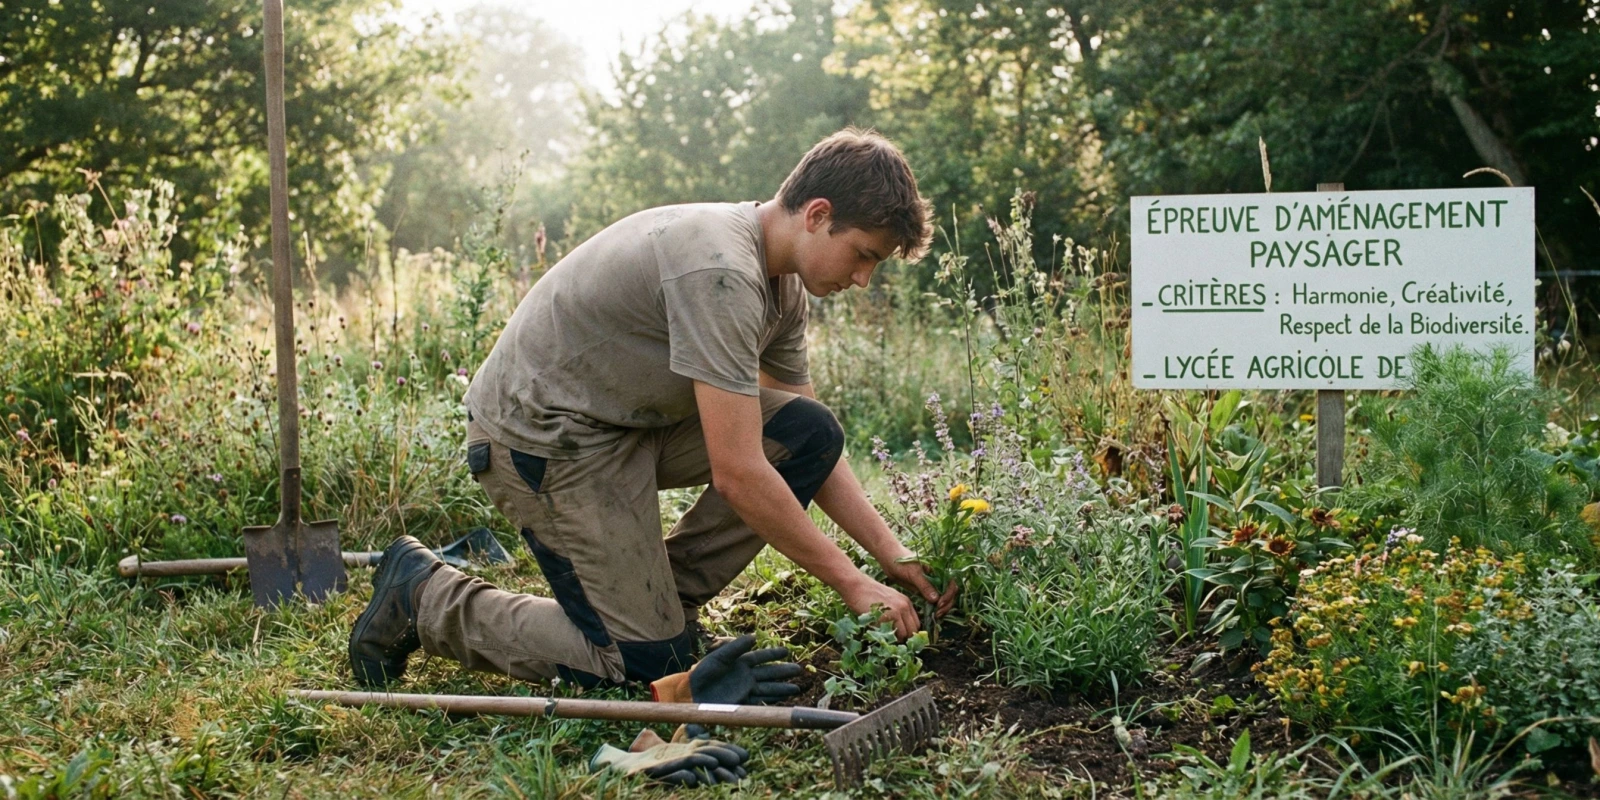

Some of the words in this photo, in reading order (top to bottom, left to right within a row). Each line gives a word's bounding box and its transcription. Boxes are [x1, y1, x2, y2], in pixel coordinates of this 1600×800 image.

[1147, 199, 1260, 235] ÉPREUVE
[1275, 196, 1509, 232] D'AMÉNAGEMENT
[1250, 239, 1403, 268] PAYSAGER
[1158, 278, 1267, 307] CRITÈRES
[1292, 282, 1396, 308] Harmonie,
[1401, 280, 1513, 307] Créativité,
[1280, 313, 1353, 342] Respect
[1359, 313, 1381, 335] de
[1388, 313, 1404, 335] la
[1410, 312, 1530, 335] Biodiversité.
[1164, 348, 1235, 380] LYCÉE
[1246, 350, 1364, 380] AGRICOLE
[1376, 355, 1407, 380] DE
